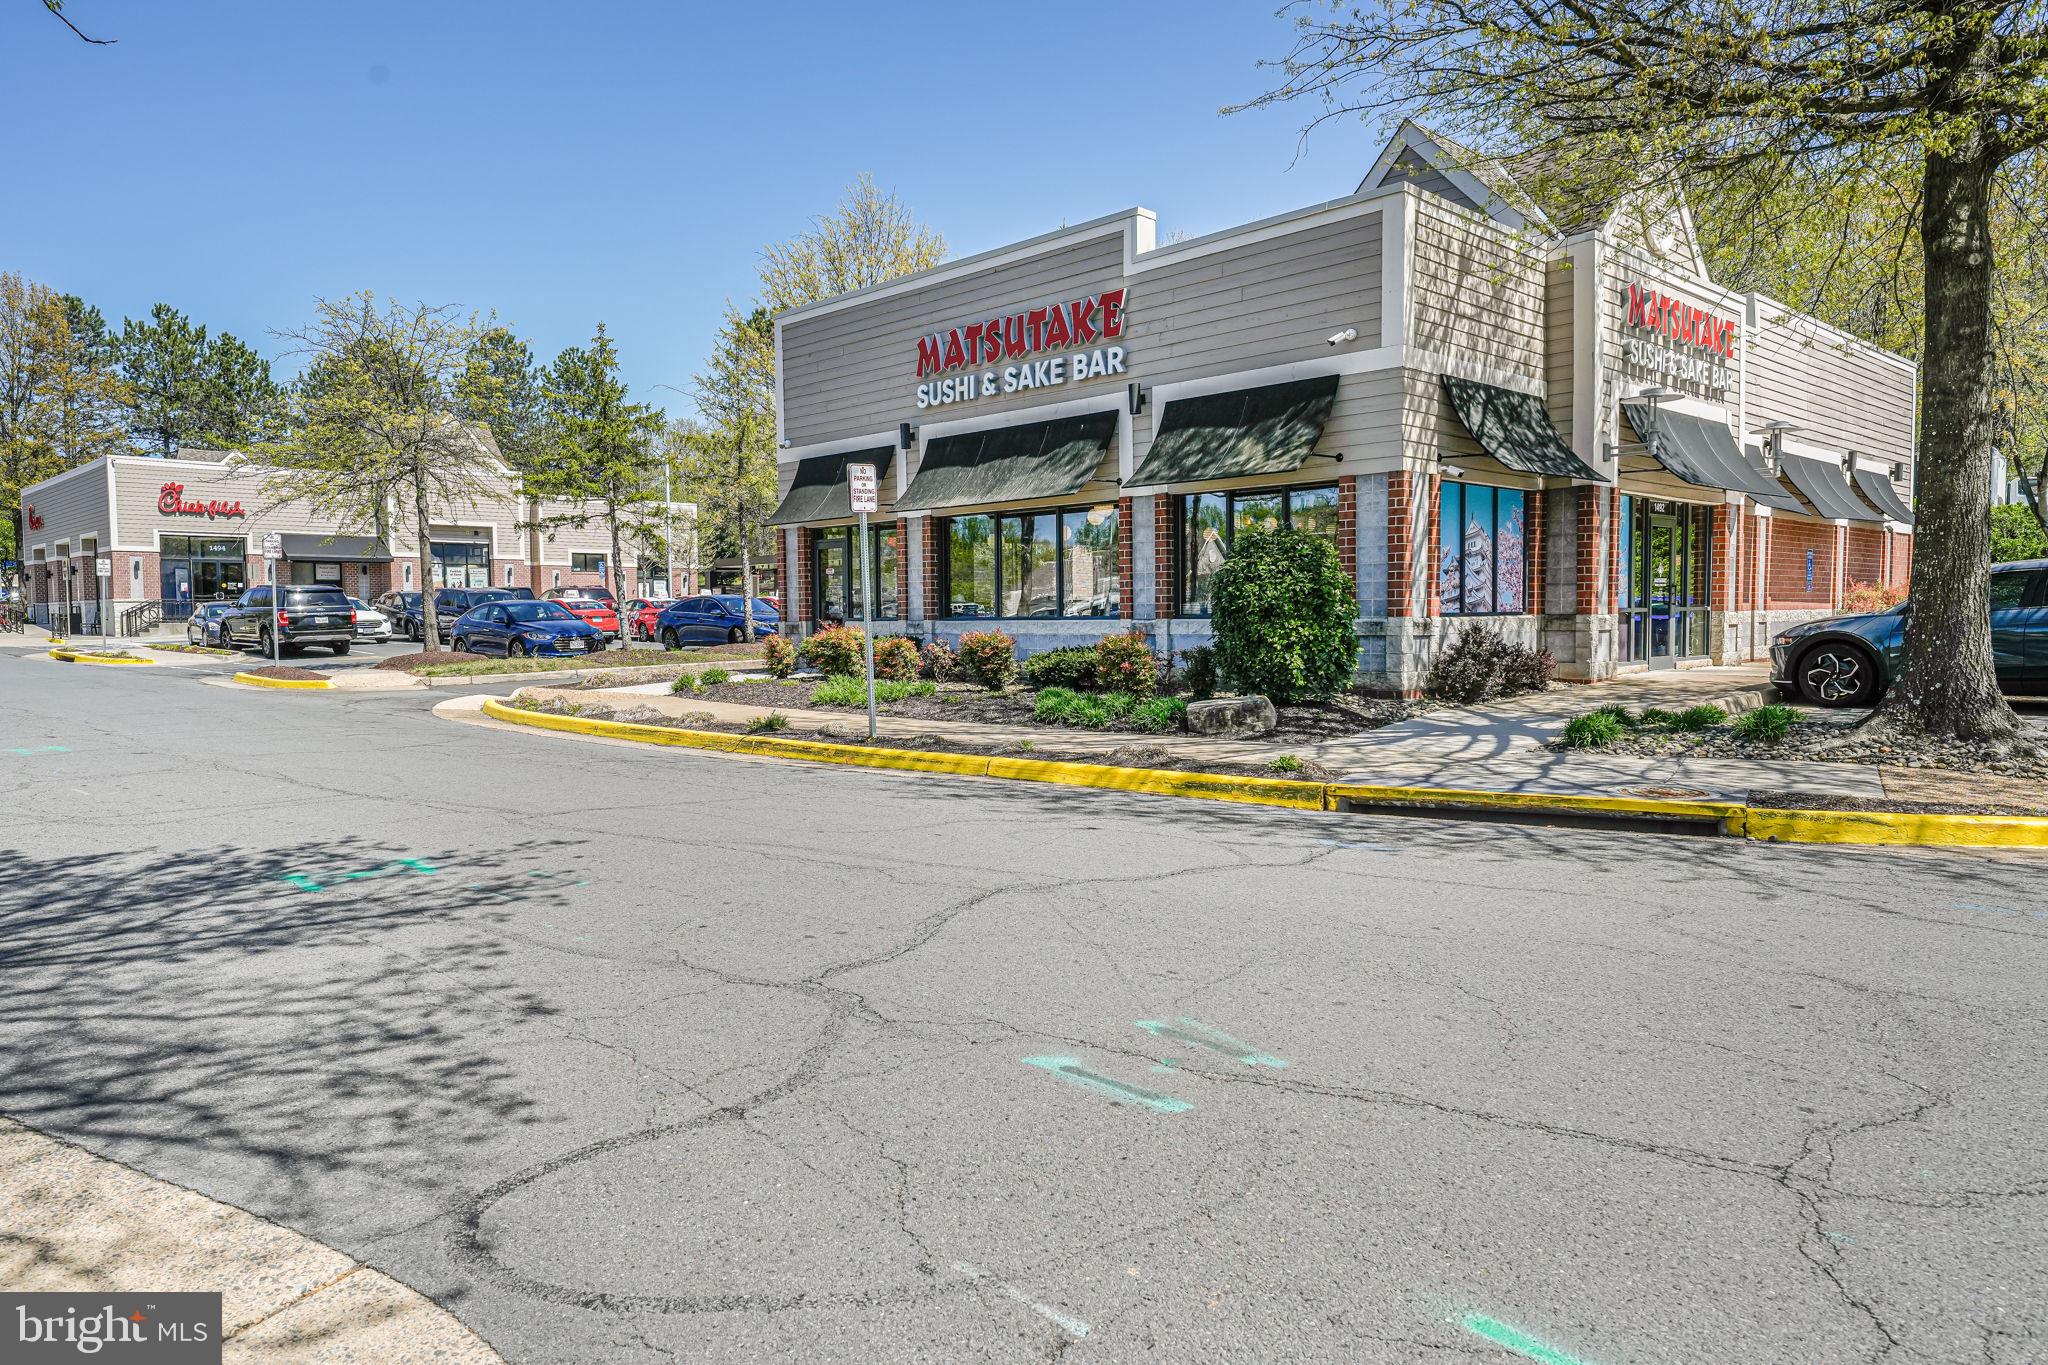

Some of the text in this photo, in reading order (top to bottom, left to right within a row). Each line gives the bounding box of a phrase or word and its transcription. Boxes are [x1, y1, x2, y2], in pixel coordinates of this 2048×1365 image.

[916, 288, 1129, 378] MATSUTAKE
[1627, 282, 1735, 359] MATSUTAKE
[916, 346, 1127, 409] SUSHI & SAKE BAR
[1629, 339, 1667, 373] SUSHI
[1680, 355, 1710, 385] SAKE
[1713, 367, 1733, 391] BAR
[1654, 502, 1665, 512] 1492
